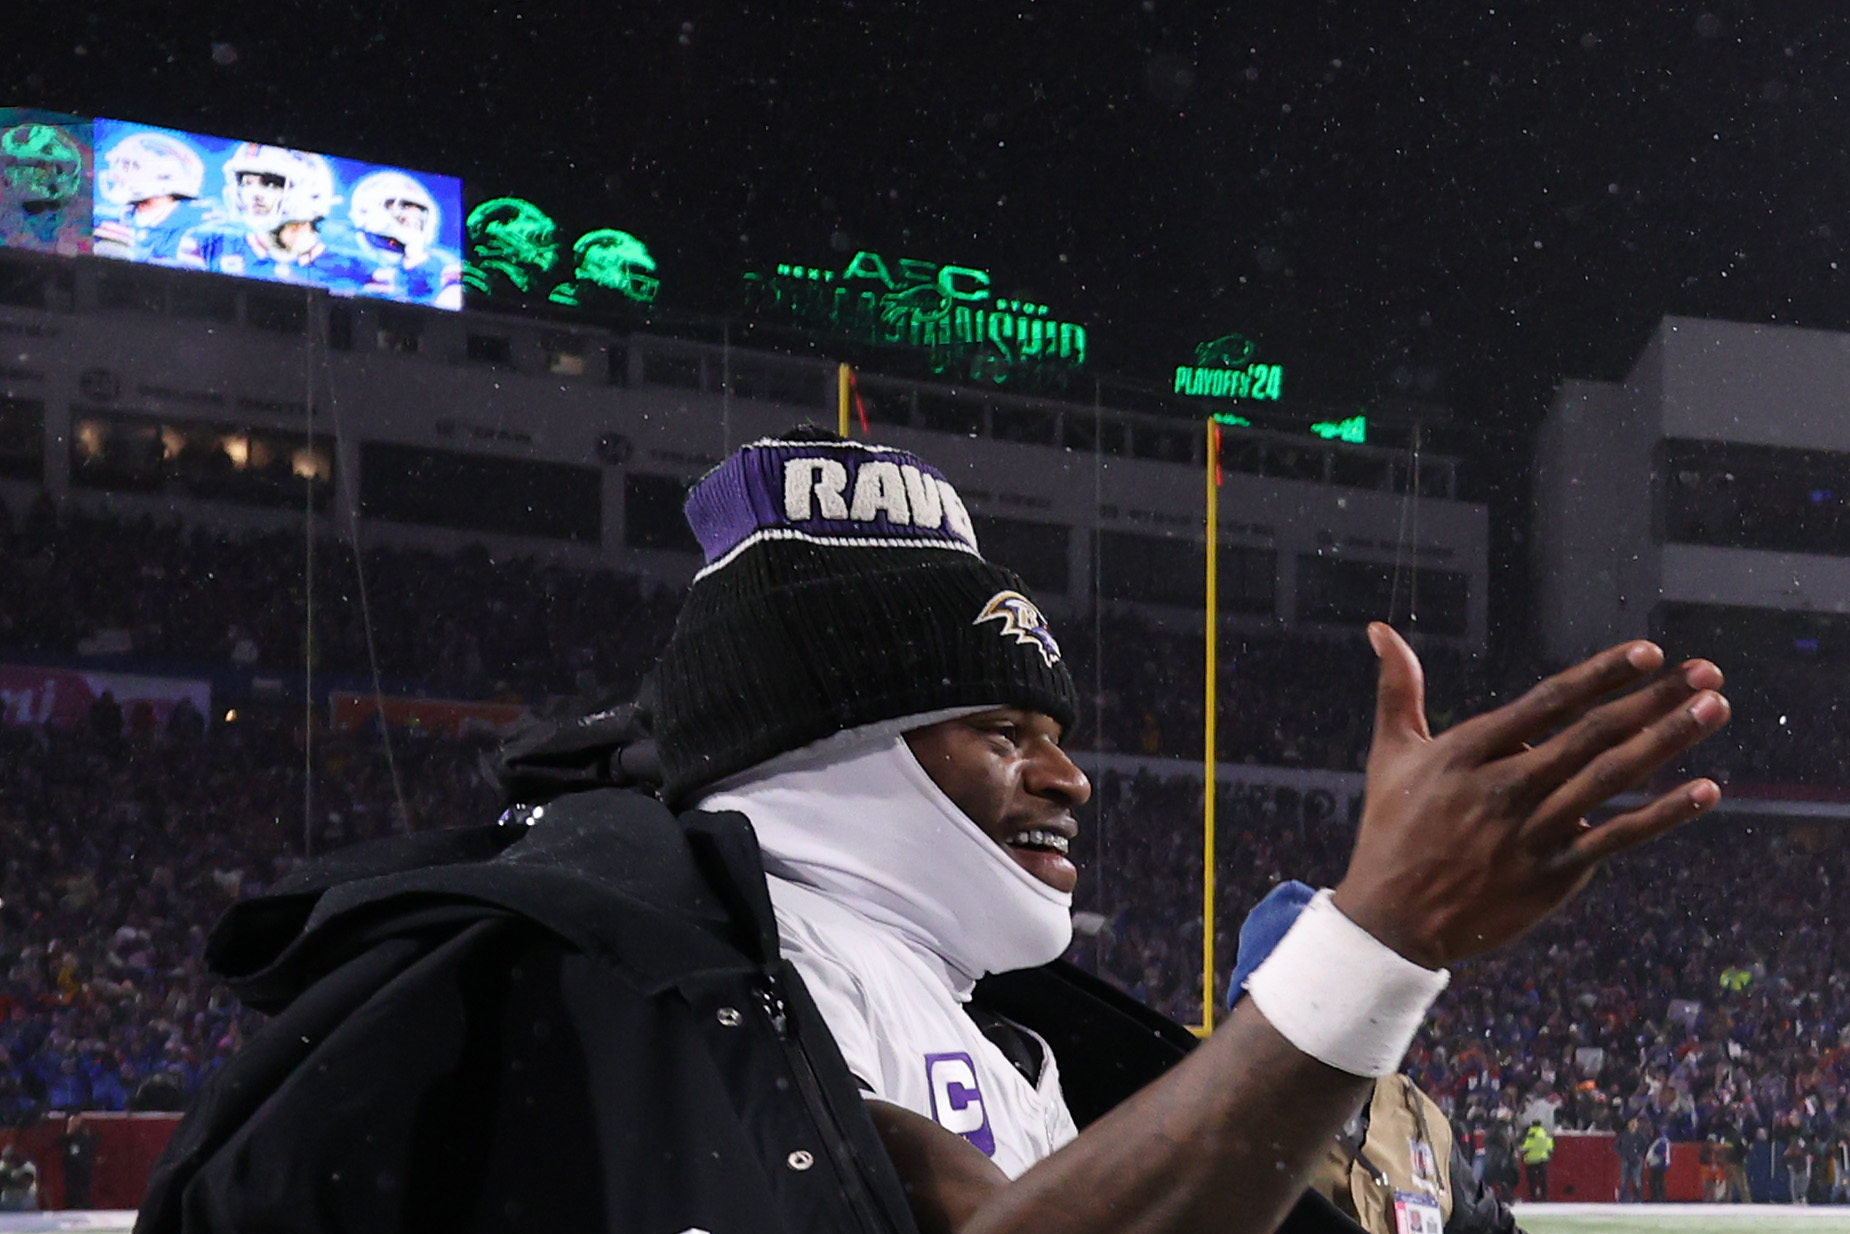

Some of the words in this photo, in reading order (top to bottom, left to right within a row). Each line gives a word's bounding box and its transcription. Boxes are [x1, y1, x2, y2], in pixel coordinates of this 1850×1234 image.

[777, 263, 835, 282] NEXT
[842, 251, 991, 300] AFC
[931, 1059, 985, 1135] C
